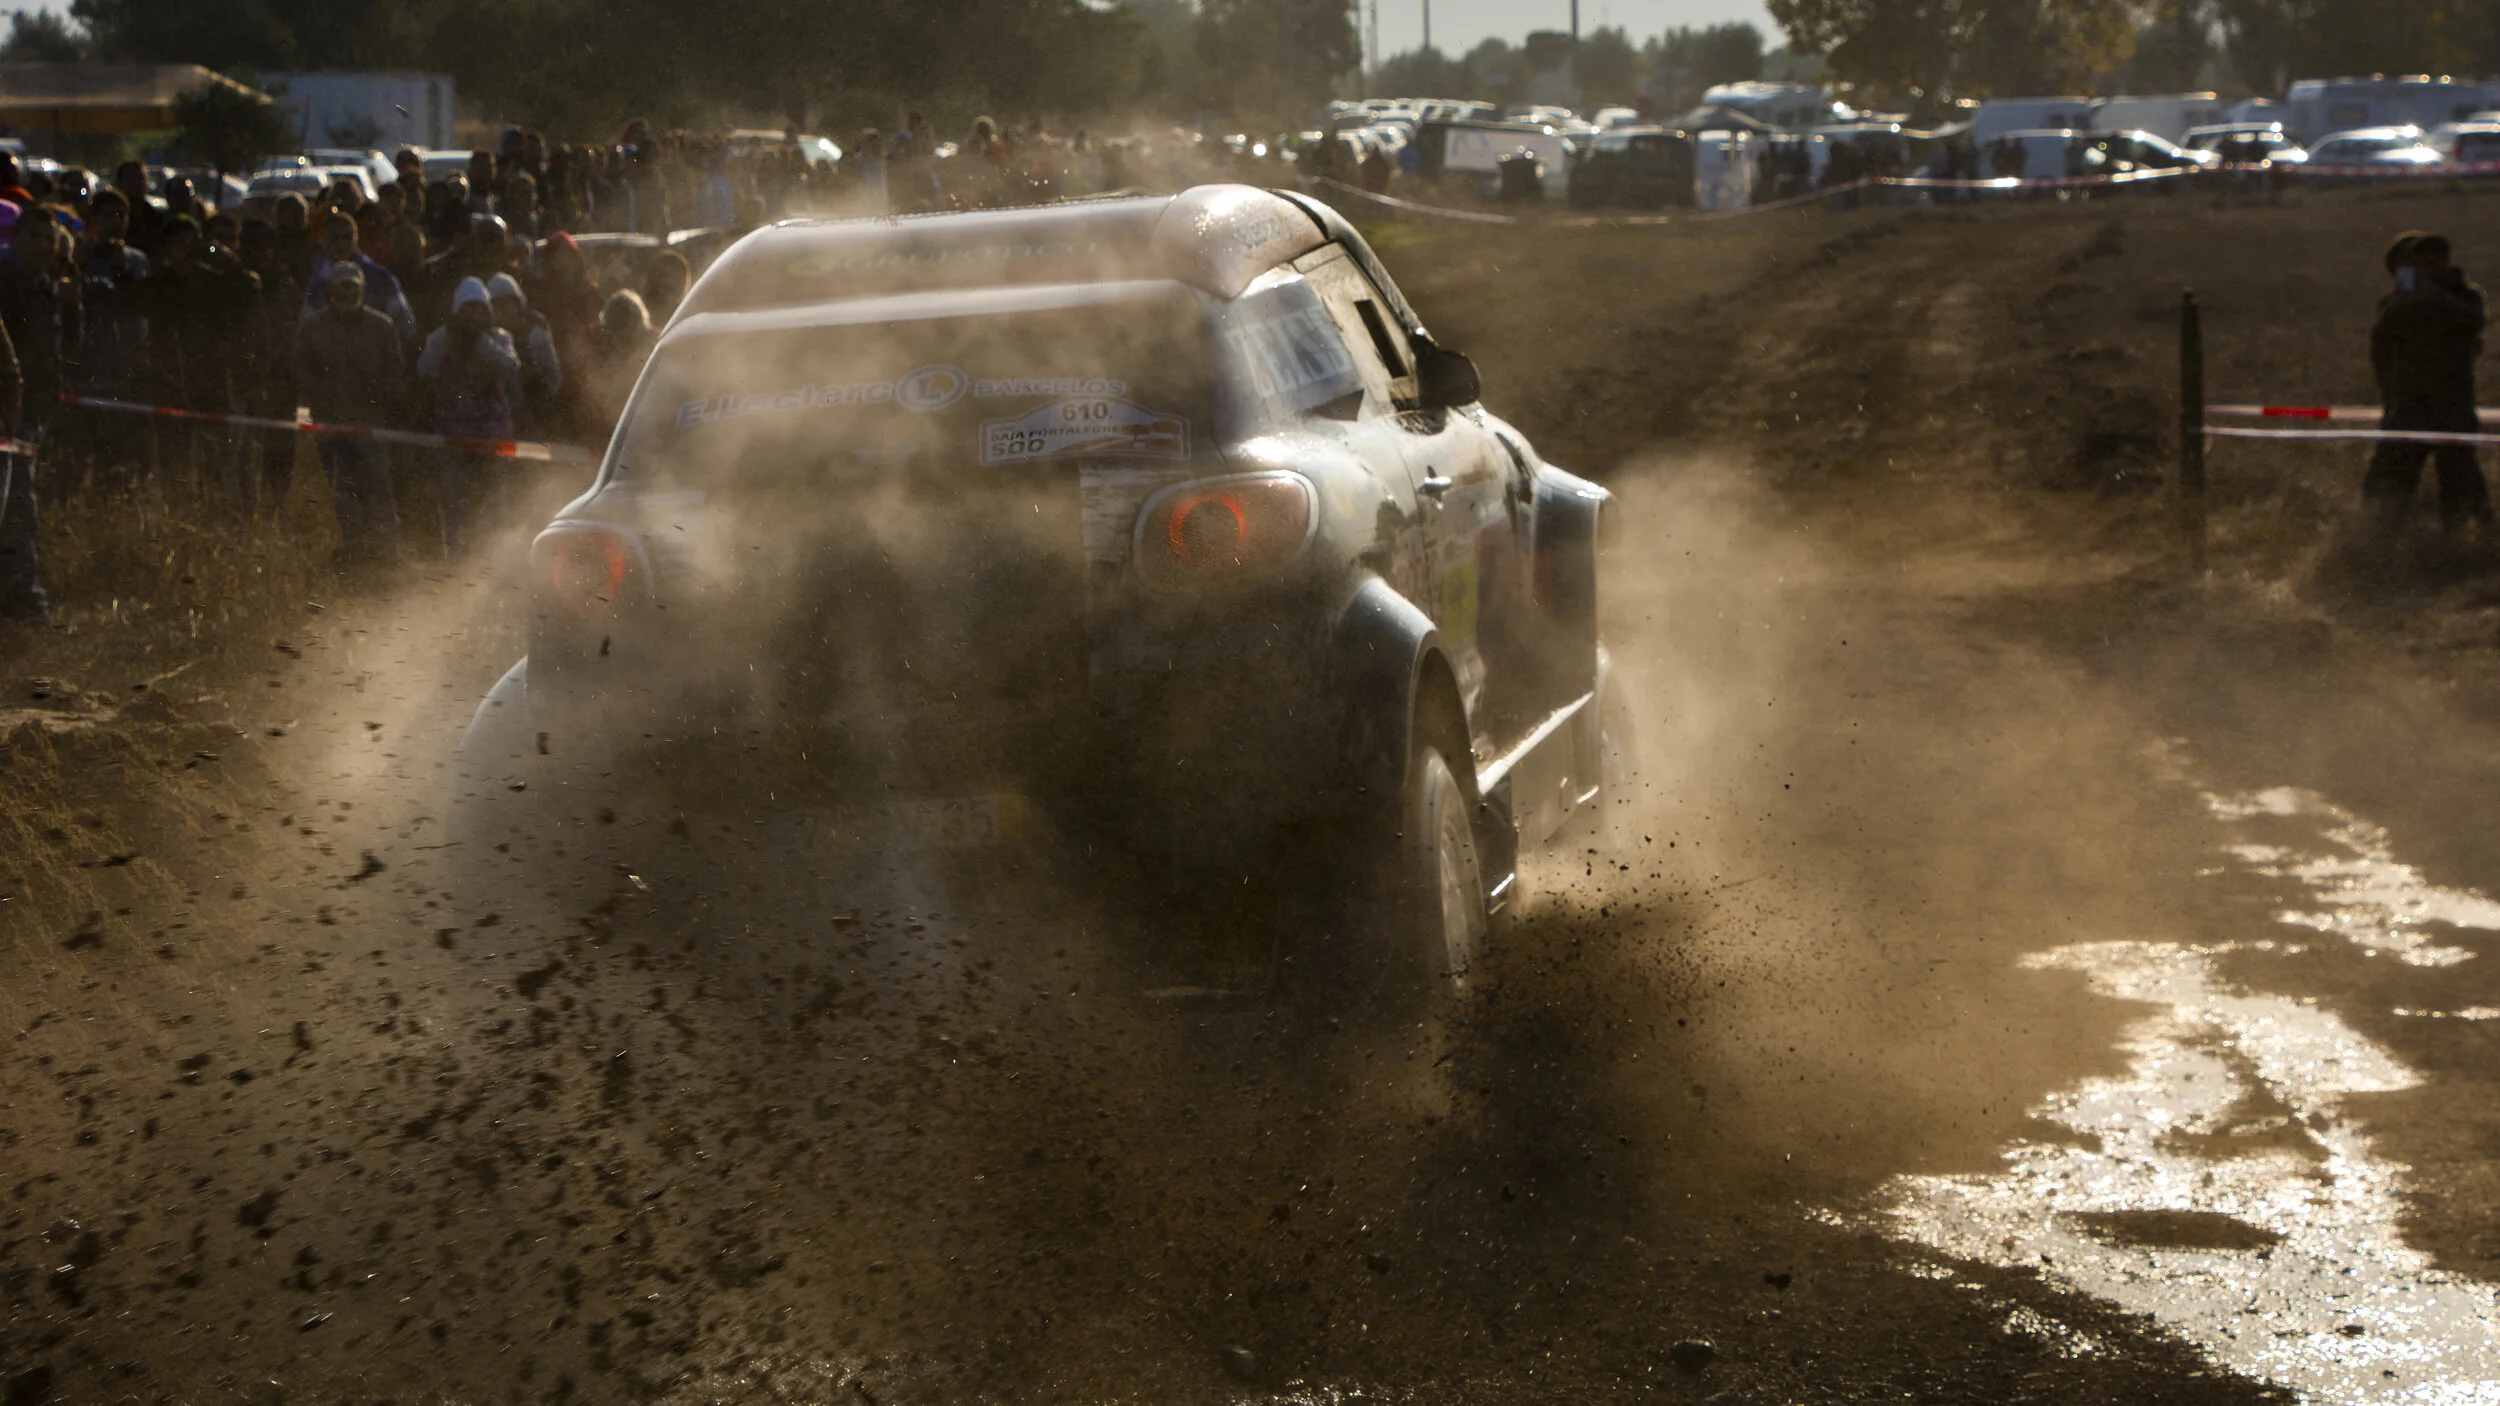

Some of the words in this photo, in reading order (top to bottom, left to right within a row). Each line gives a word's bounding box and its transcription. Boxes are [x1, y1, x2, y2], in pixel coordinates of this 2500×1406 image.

[975, 378, 1125, 397] BARCELOS
[1062, 403, 1108, 421] 610
[991, 429, 1025, 441] BAJA
[991, 438, 1046, 457] 500
